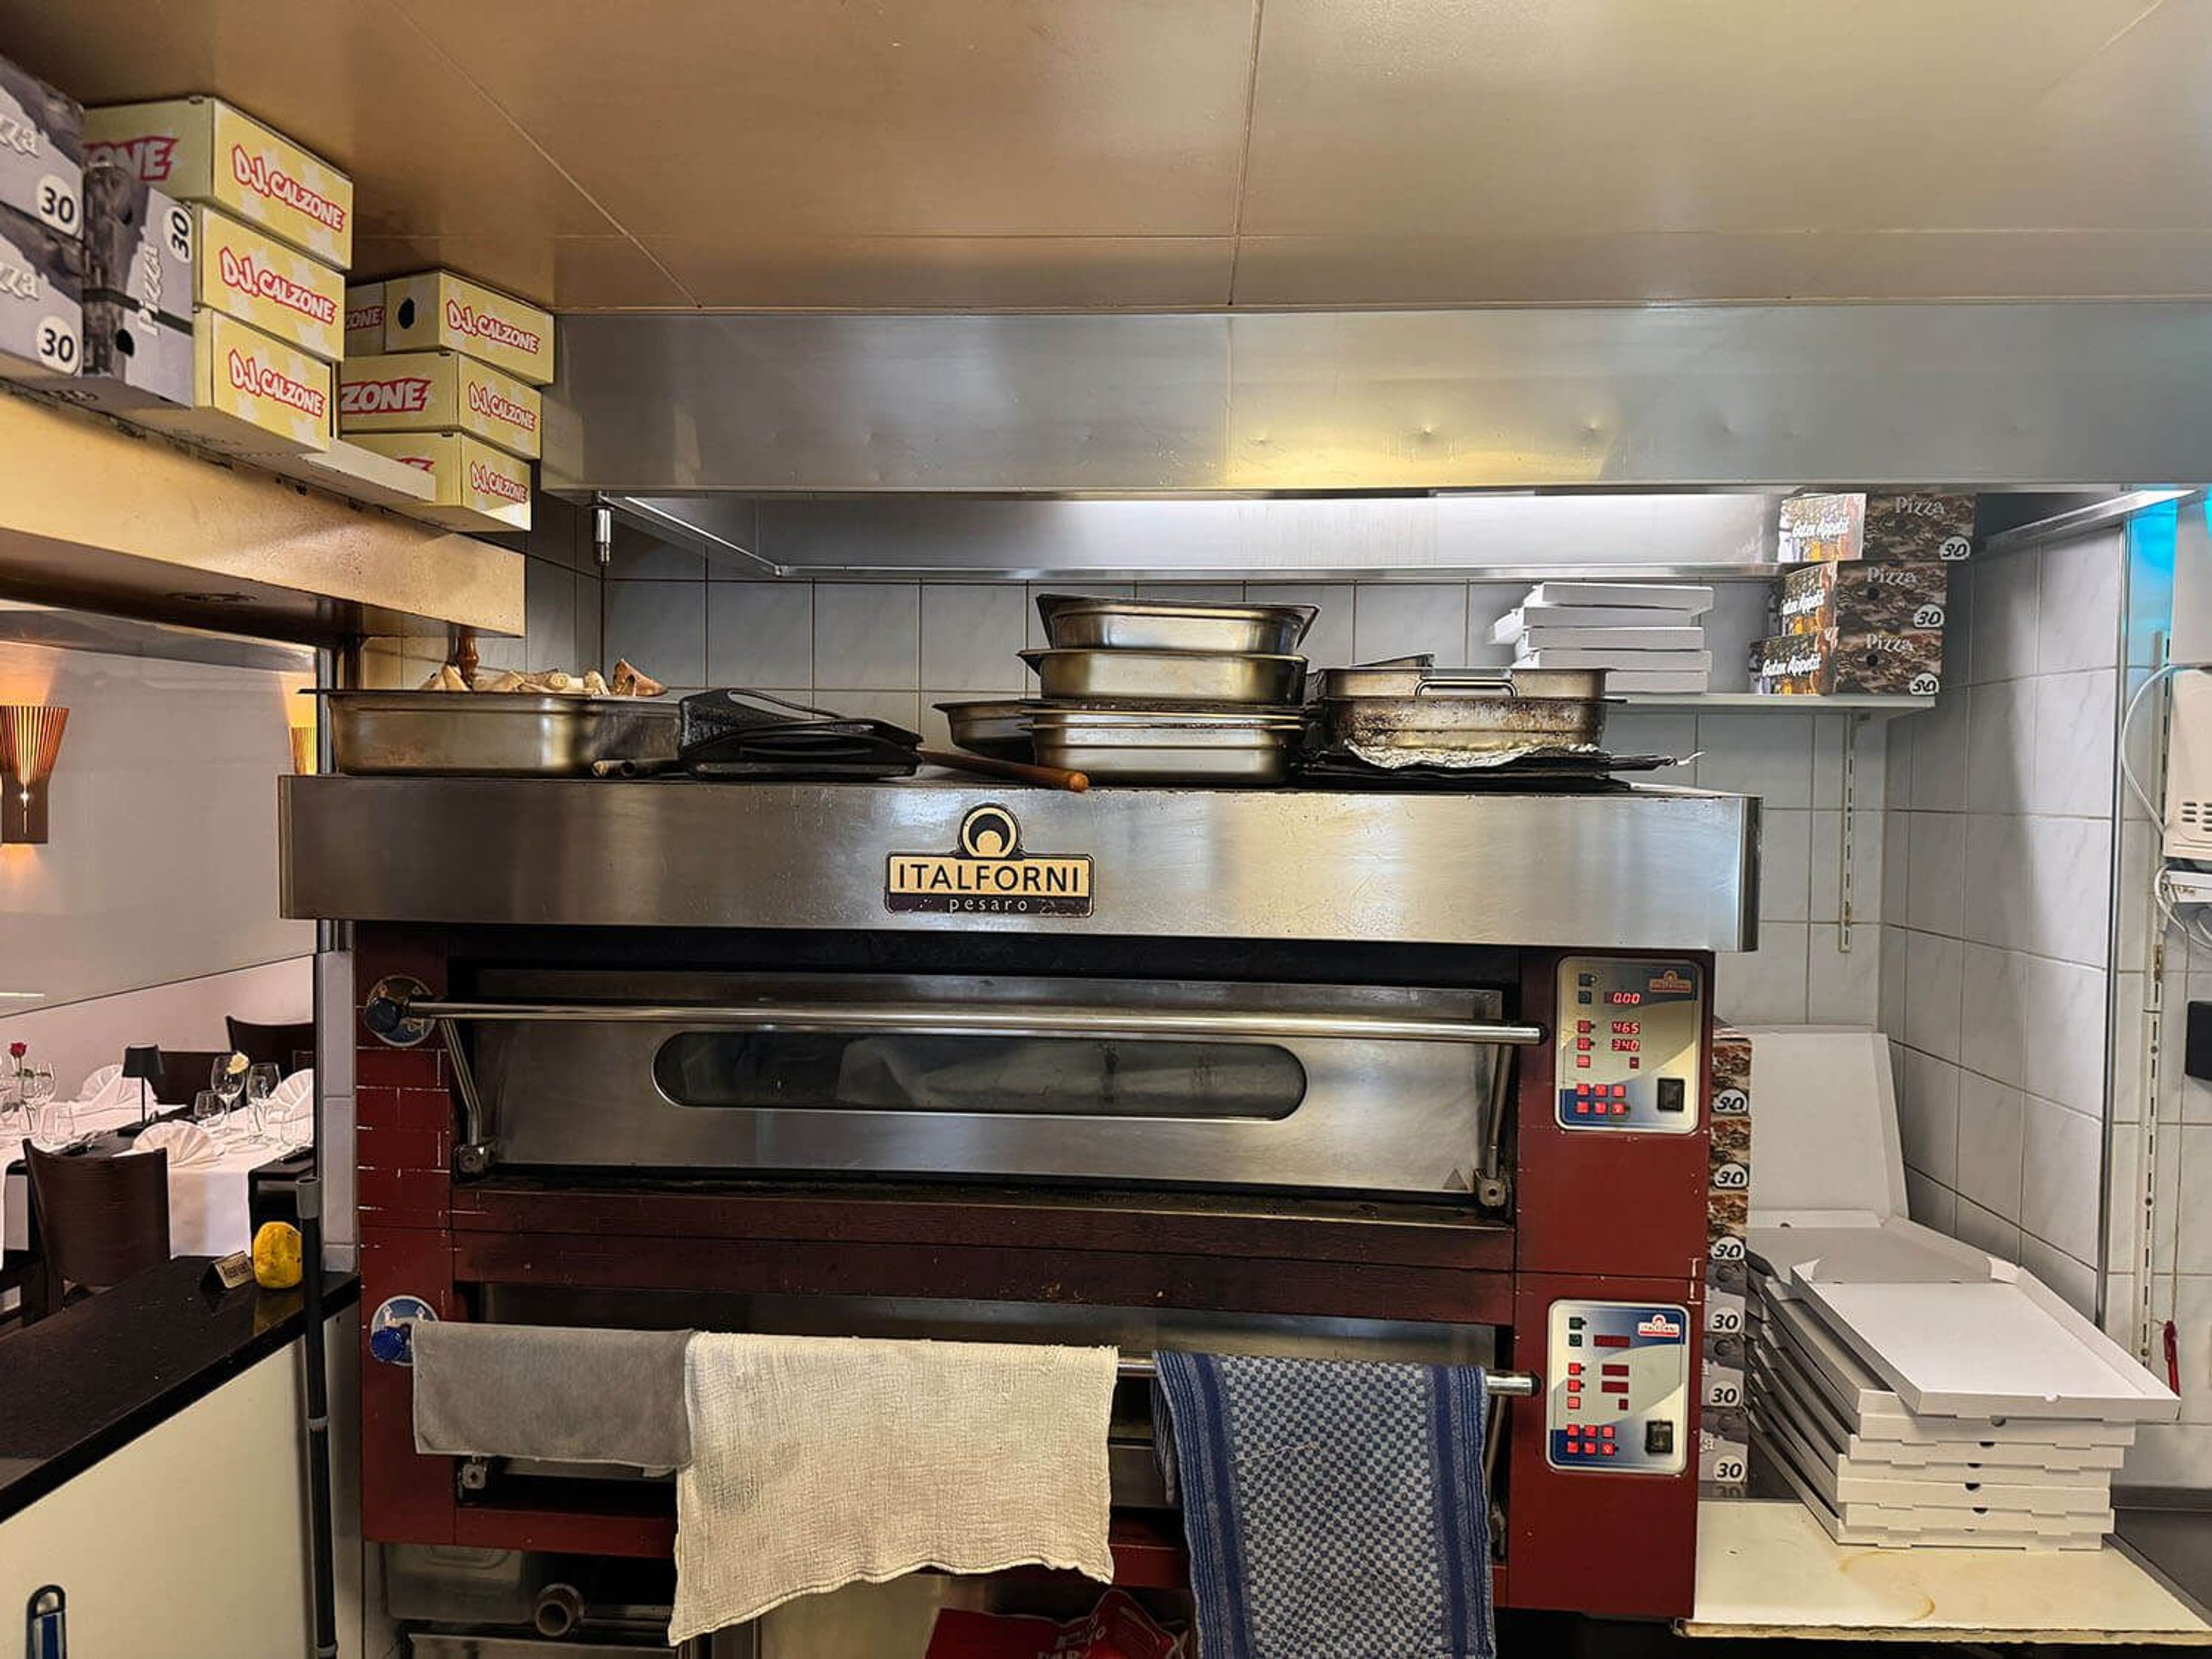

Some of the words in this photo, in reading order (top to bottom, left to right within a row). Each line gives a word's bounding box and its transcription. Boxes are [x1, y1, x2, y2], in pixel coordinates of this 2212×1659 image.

[41, 186, 74, 223] 30
[269, 171, 346, 232] CALZONE
[172, 211, 190, 258] 30
[257, 270, 338, 324] CALZONE
[476, 315, 540, 354] CALZONE
[41, 328, 74, 362] 30
[260, 369, 325, 417] CALZONE
[490, 395, 536, 431] CALZONE
[489, 472, 527, 503] CALZONE
[1896, 497, 1945, 516] Pizza
[1942, 543, 1967, 557] 30
[1867, 566, 1918, 585] Pizza
[1916, 611, 1942, 625] 30
[1866, 634, 1914, 653] Pizza
[1911, 679, 1937, 692] 30
[899, 863, 1078, 893] ITALFORNI
[949, 899, 1028, 914] pesaro
[1717, 1096, 1745, 1111] 30
[1717, 1171, 1744, 1185] 30
[1714, 1244, 1742, 1259] 30
[1713, 1314, 1738, 1330] 30
[1711, 1388, 1737, 1404] 30
[1716, 1462, 1743, 1479] 30
